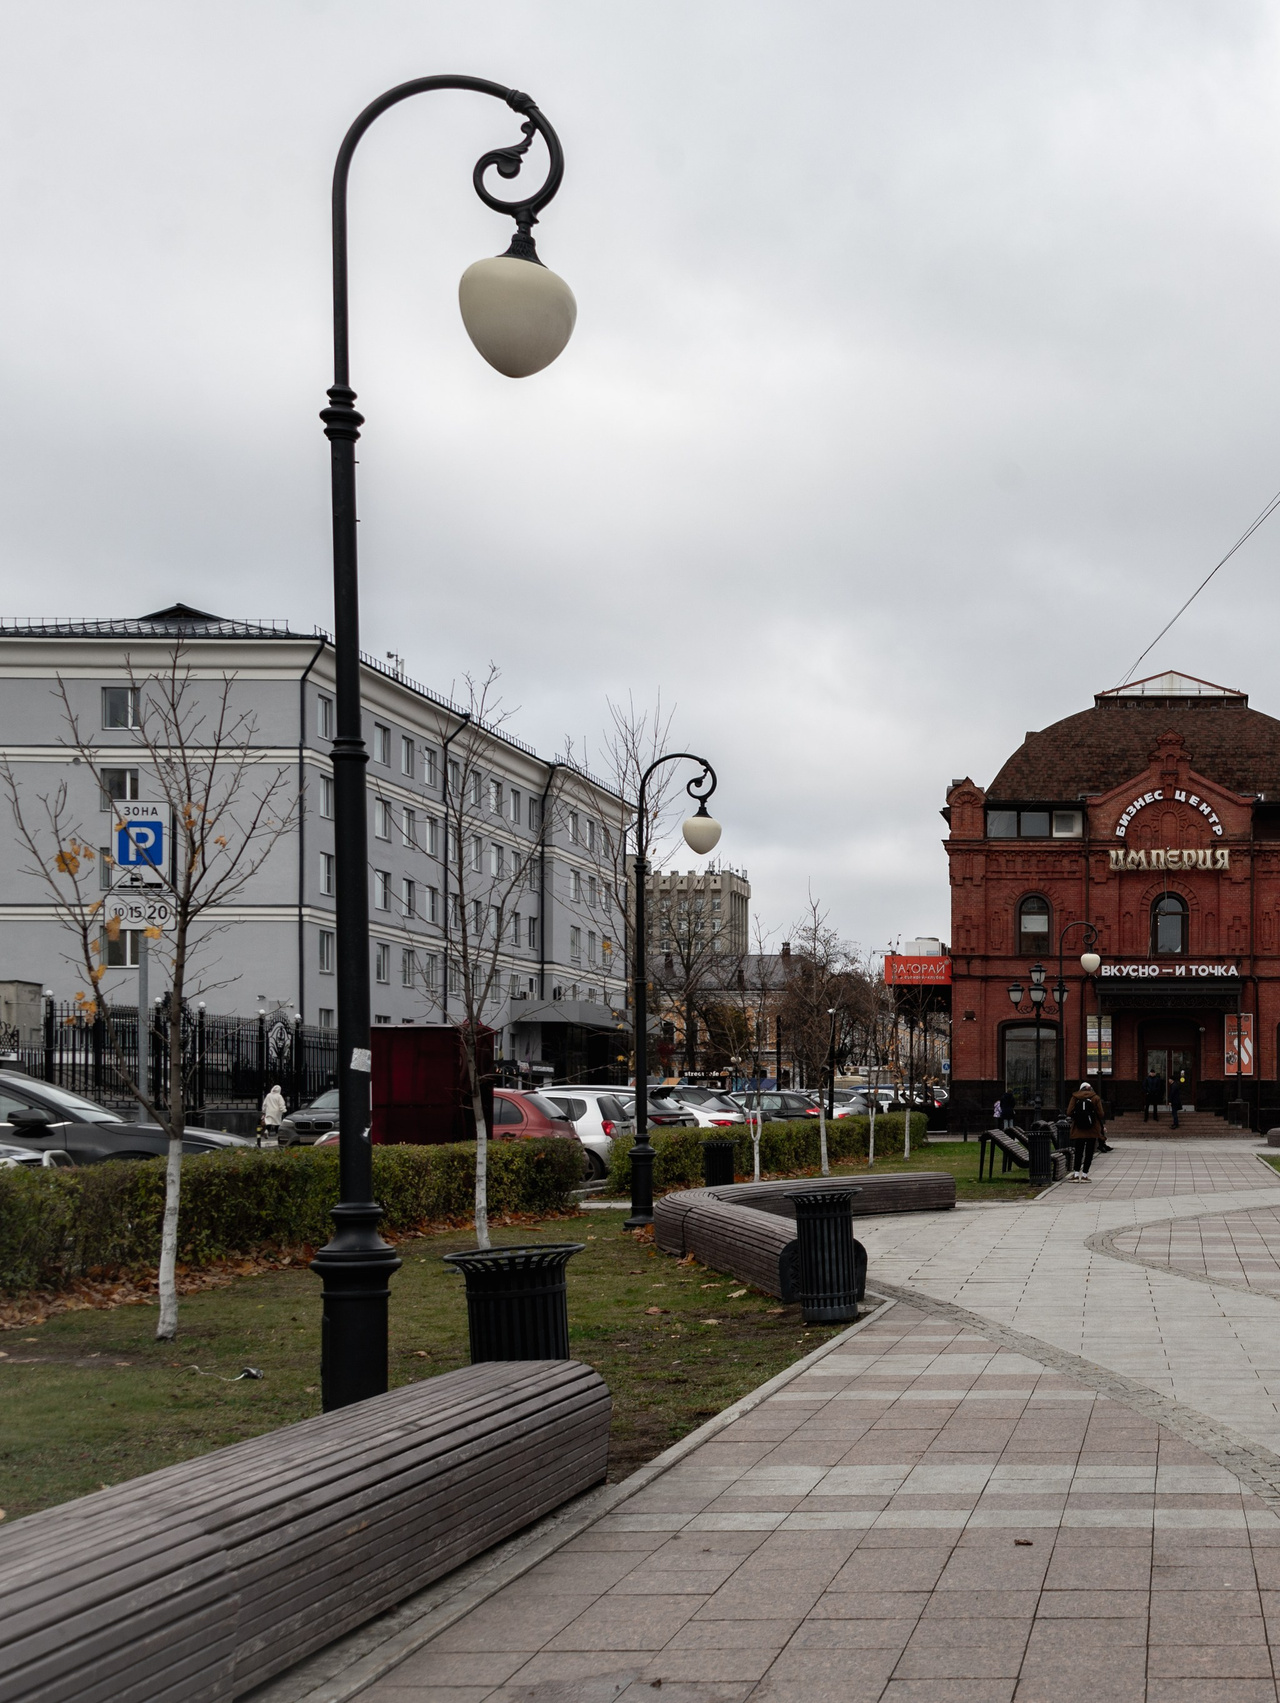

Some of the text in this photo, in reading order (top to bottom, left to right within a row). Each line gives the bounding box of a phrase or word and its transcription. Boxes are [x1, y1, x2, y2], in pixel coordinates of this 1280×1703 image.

[124, 806, 158, 816] ЗОНА
[1115, 790, 1223, 837] БИЗНЕС ЦЕНТР
[1109, 848, 1230, 871] ИМПЕРИЯ
[113, 905, 168, 920] 10 15 20
[1101, 965, 1160, 977] ВКУСНО
[1175, 965, 1186, 976] И
[1189, 965, 1239, 976] ТОЧКА
